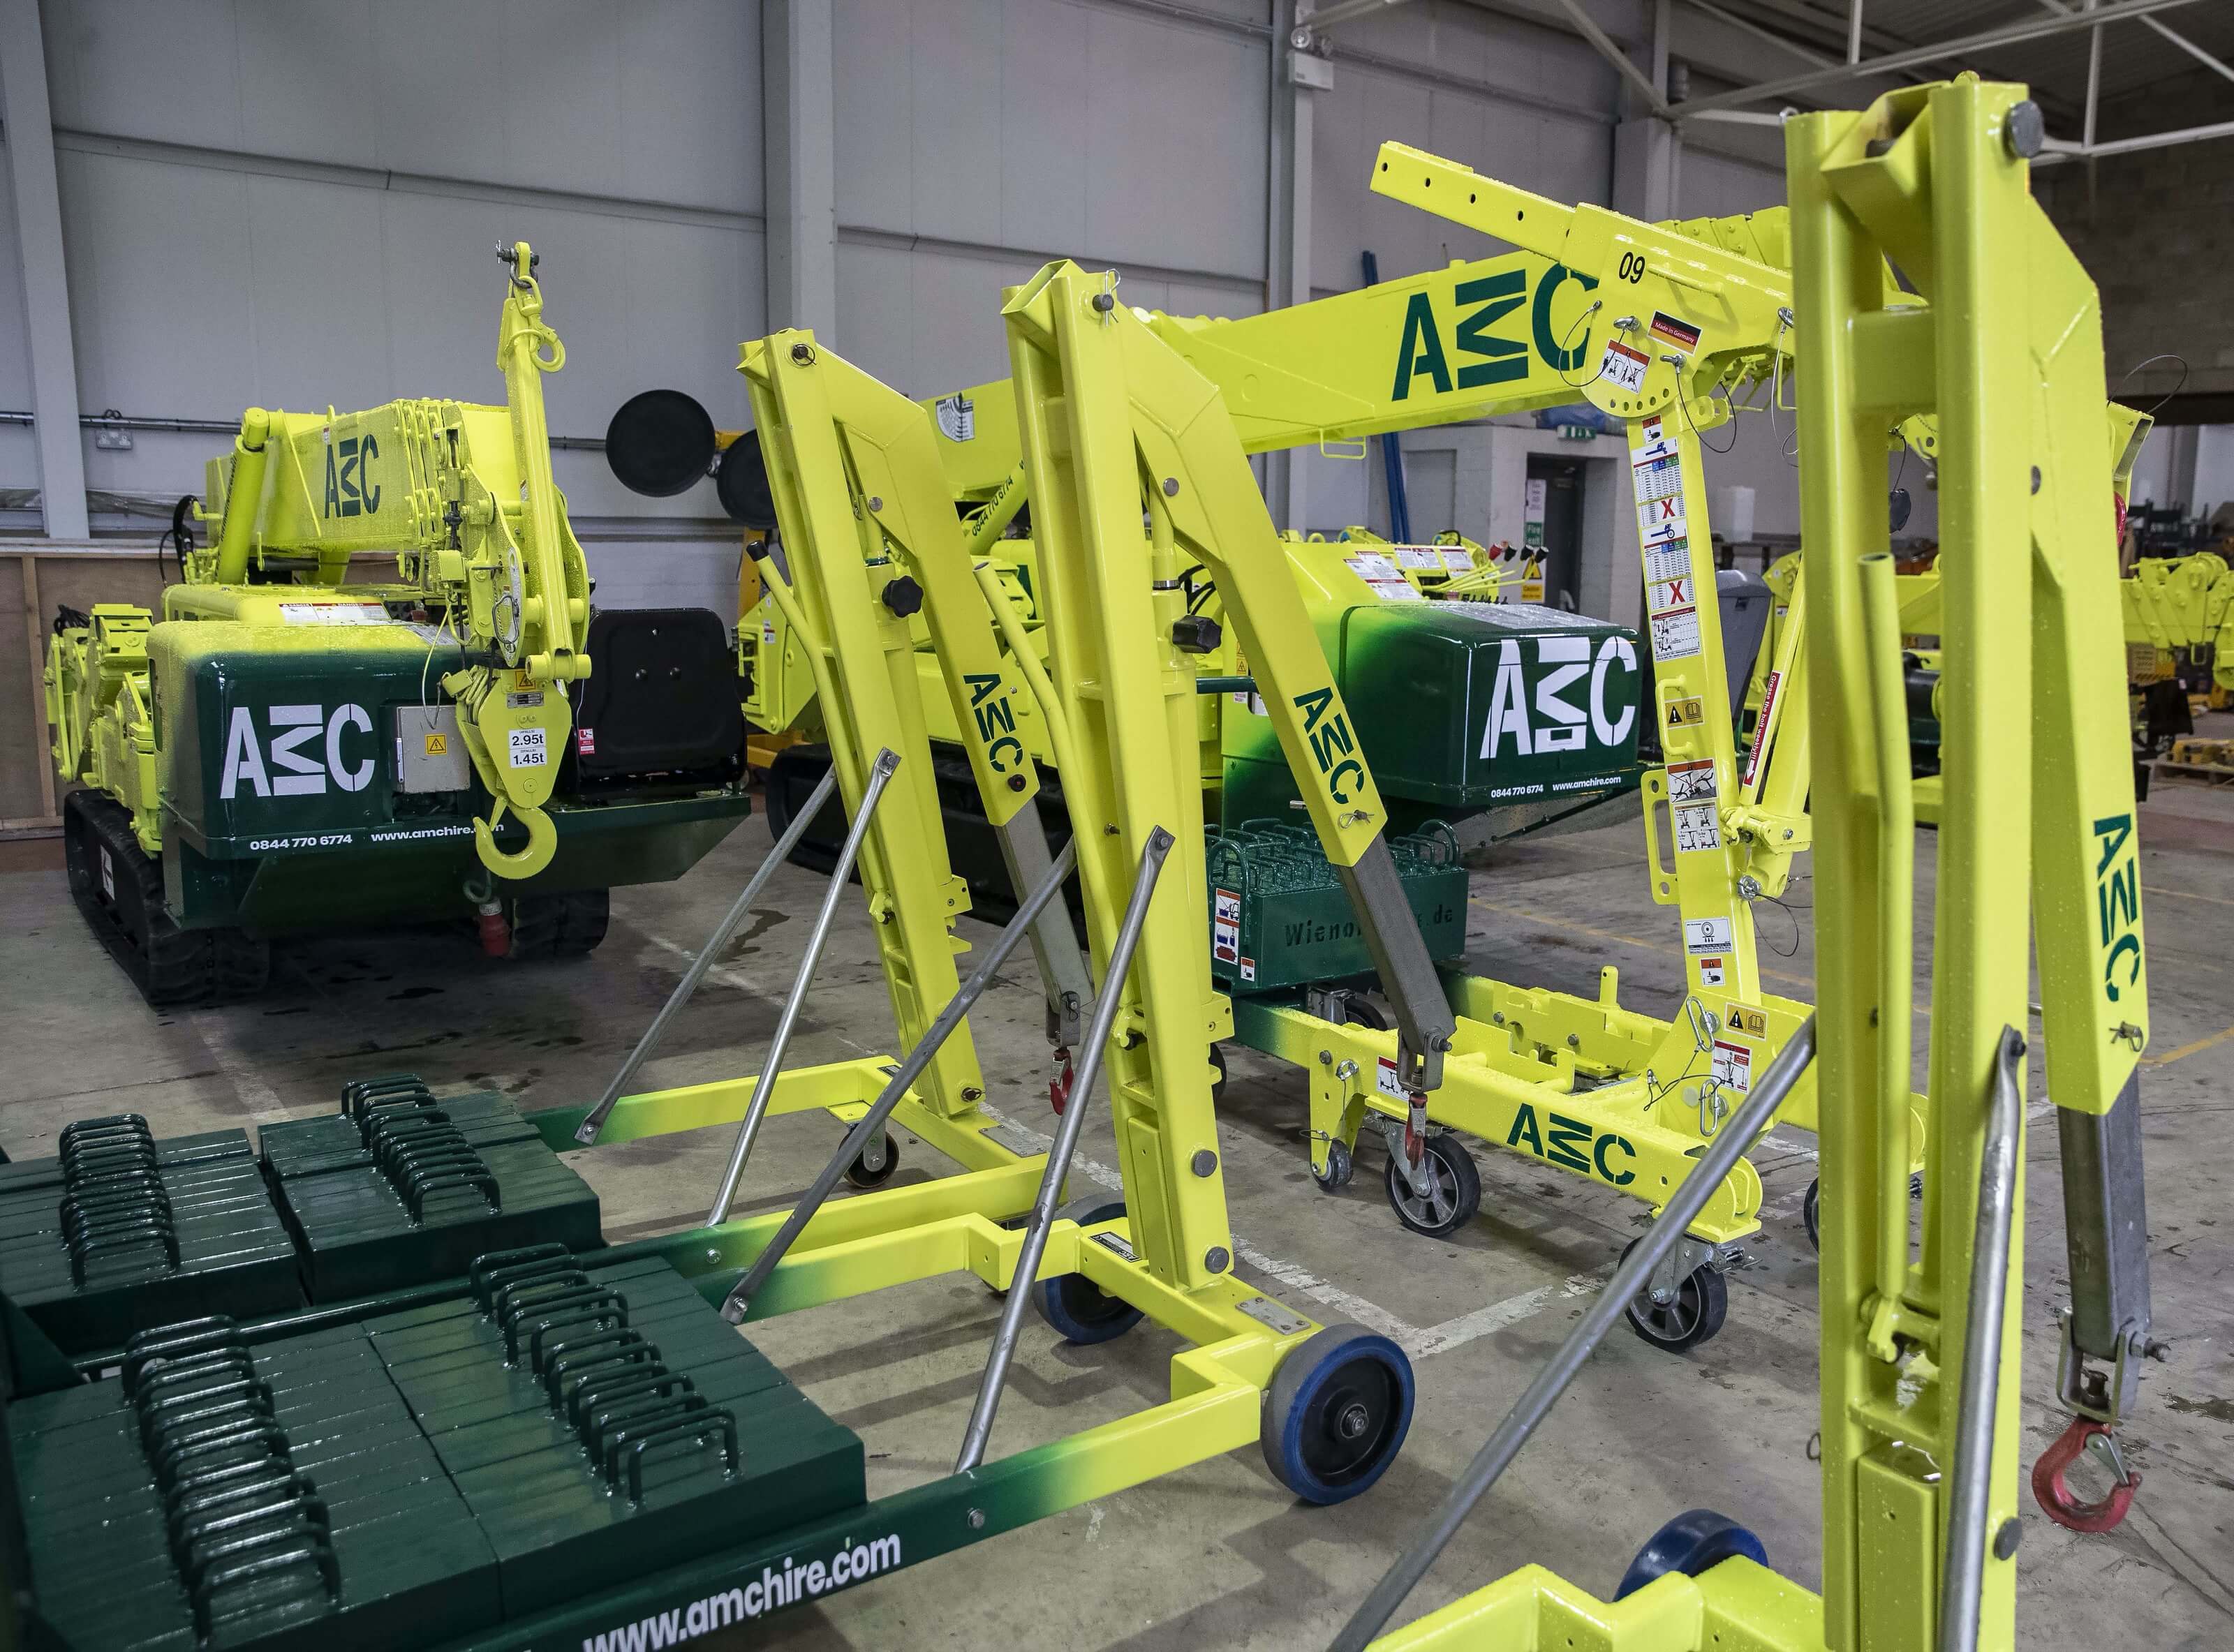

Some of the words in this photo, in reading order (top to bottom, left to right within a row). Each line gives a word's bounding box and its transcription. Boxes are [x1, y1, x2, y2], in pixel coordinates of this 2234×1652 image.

[1618, 251, 1645, 284] 09
[1655, 322, 1669, 332] Made
[1673, 330, 1695, 343] Germany
[1479, 635, 1638, 759] AMC
[1766, 675, 1777, 701] Grease
[512, 734, 544, 746] 2.95t
[220, 704, 376, 799] AMC
[513, 752, 545, 765] 1.45t
[1490, 789, 1511, 798] 0844
[1512, 787, 1525, 796] 770
[1526, 784, 1544, 794] 6774
[1552, 776, 1621, 791] www.amchire.com
[250, 839, 290, 850] 0844
[290, 837, 316, 848] 770
[320, 834, 353, 846] 6774
[371, 823, 505, 842] www.amchire.m
[582, 1533, 901, 1652] www.amchire.com
